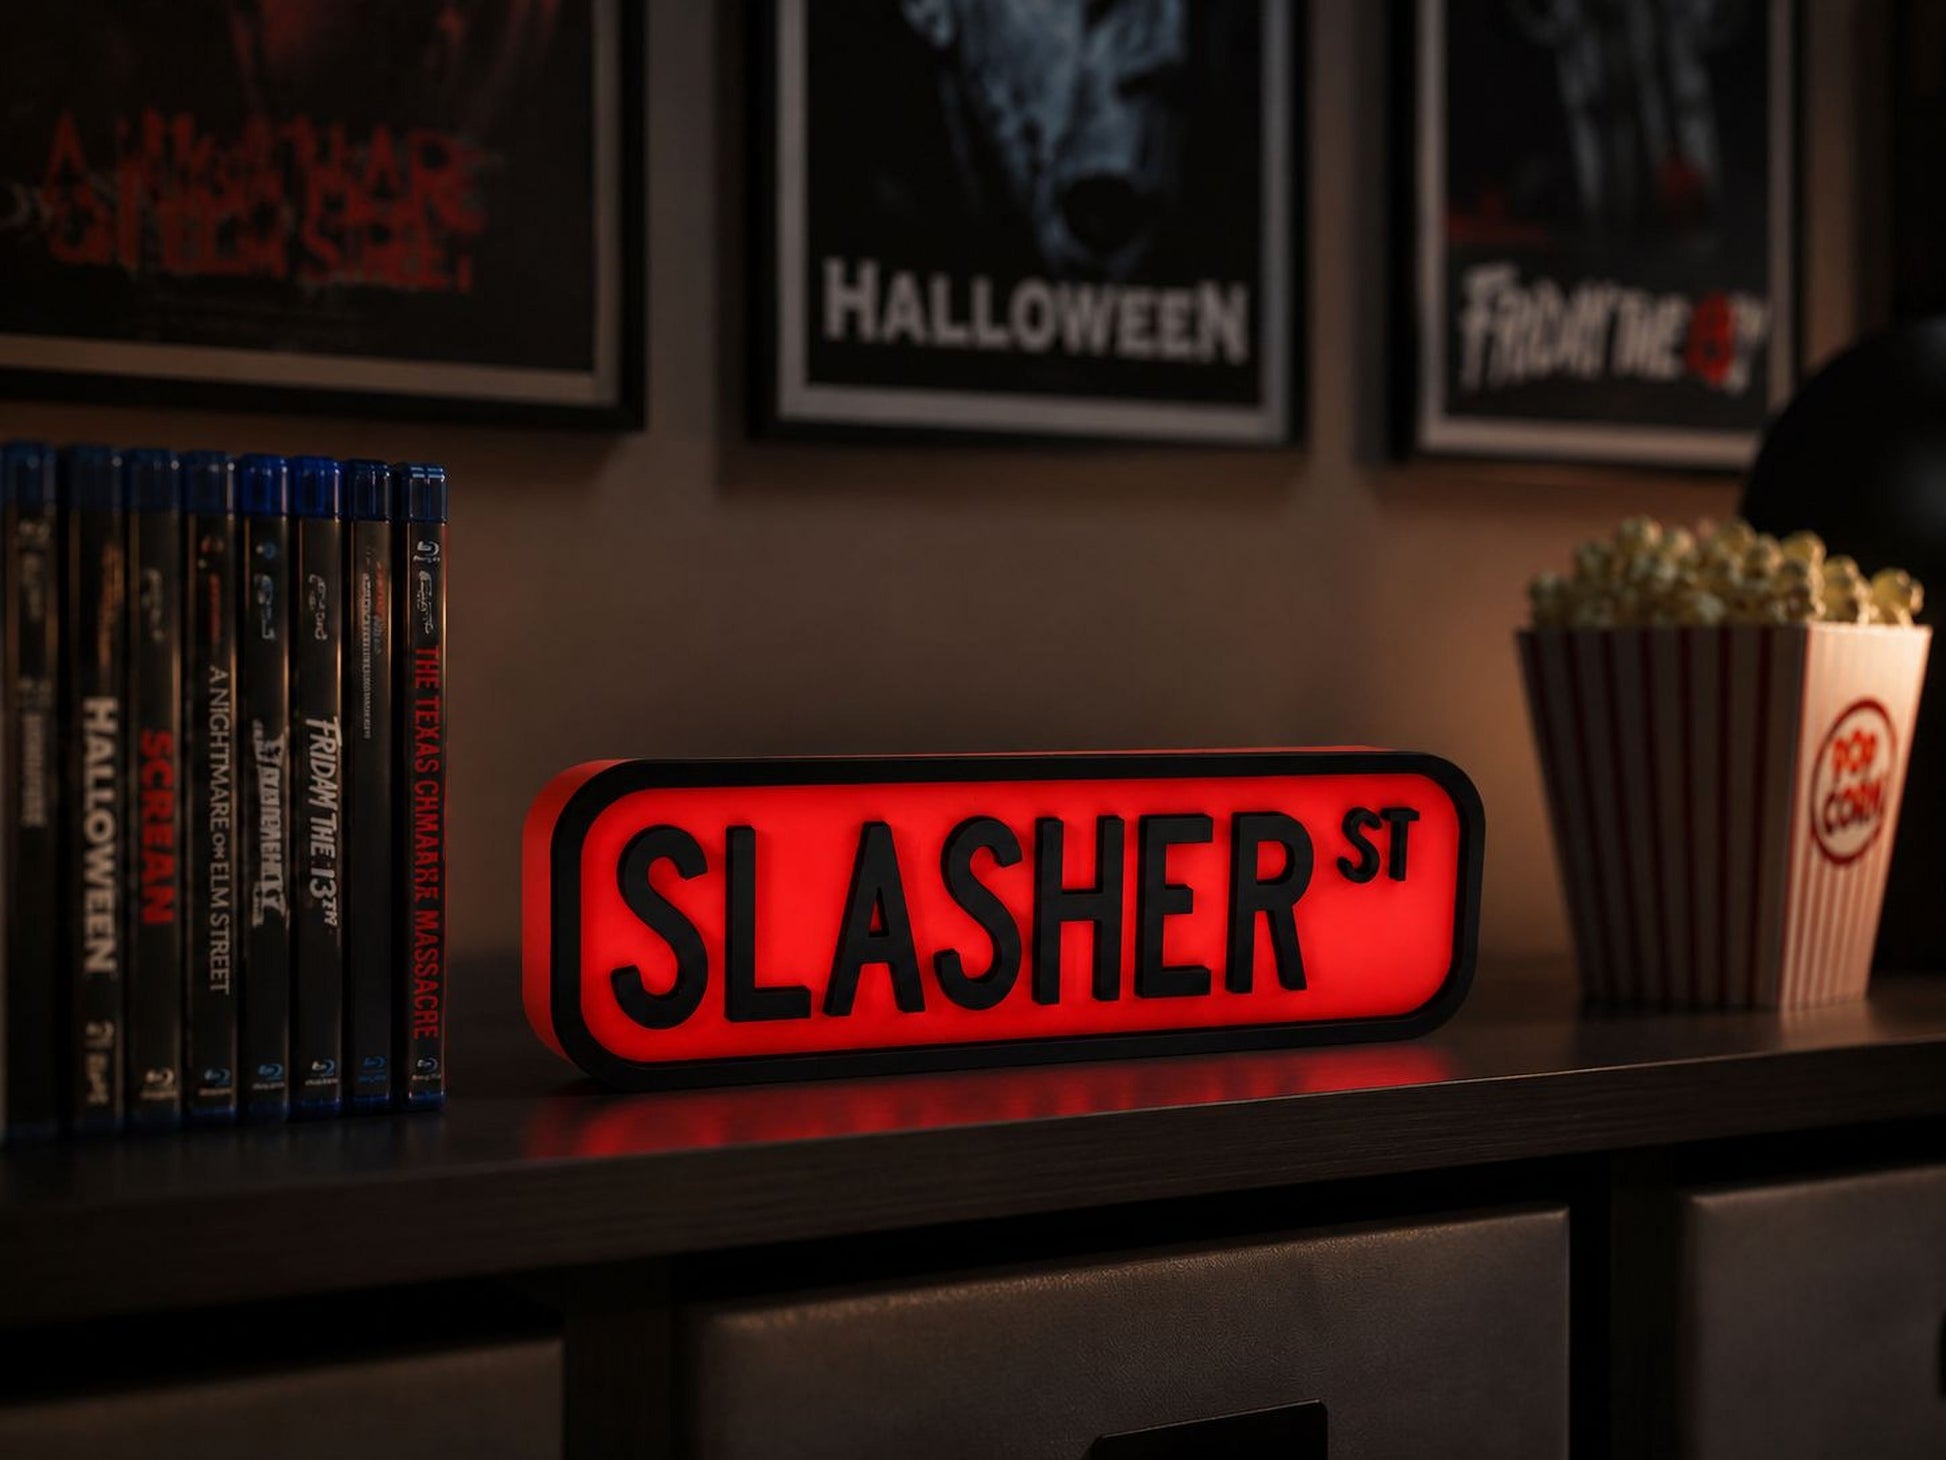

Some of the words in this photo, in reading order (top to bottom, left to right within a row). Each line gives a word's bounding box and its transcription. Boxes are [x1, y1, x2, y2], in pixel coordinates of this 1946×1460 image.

[822, 254, 1250, 366] HALLOWEEN
[208, 665, 227, 685] A
[414, 645, 440, 689] THE
[208, 688, 229, 831] NIGHTMARE
[414, 695, 440, 775] TEXAS
[82, 696, 118, 976] HALLOWEEN
[307, 811, 338, 859] THE
[208, 862, 229, 909] ELM
[610, 811, 1314, 1030] SLASHER
[1336, 806, 1420, 883] ST
[208, 913, 229, 996] STREET
[412, 910, 440, 1040] MASSACRE
